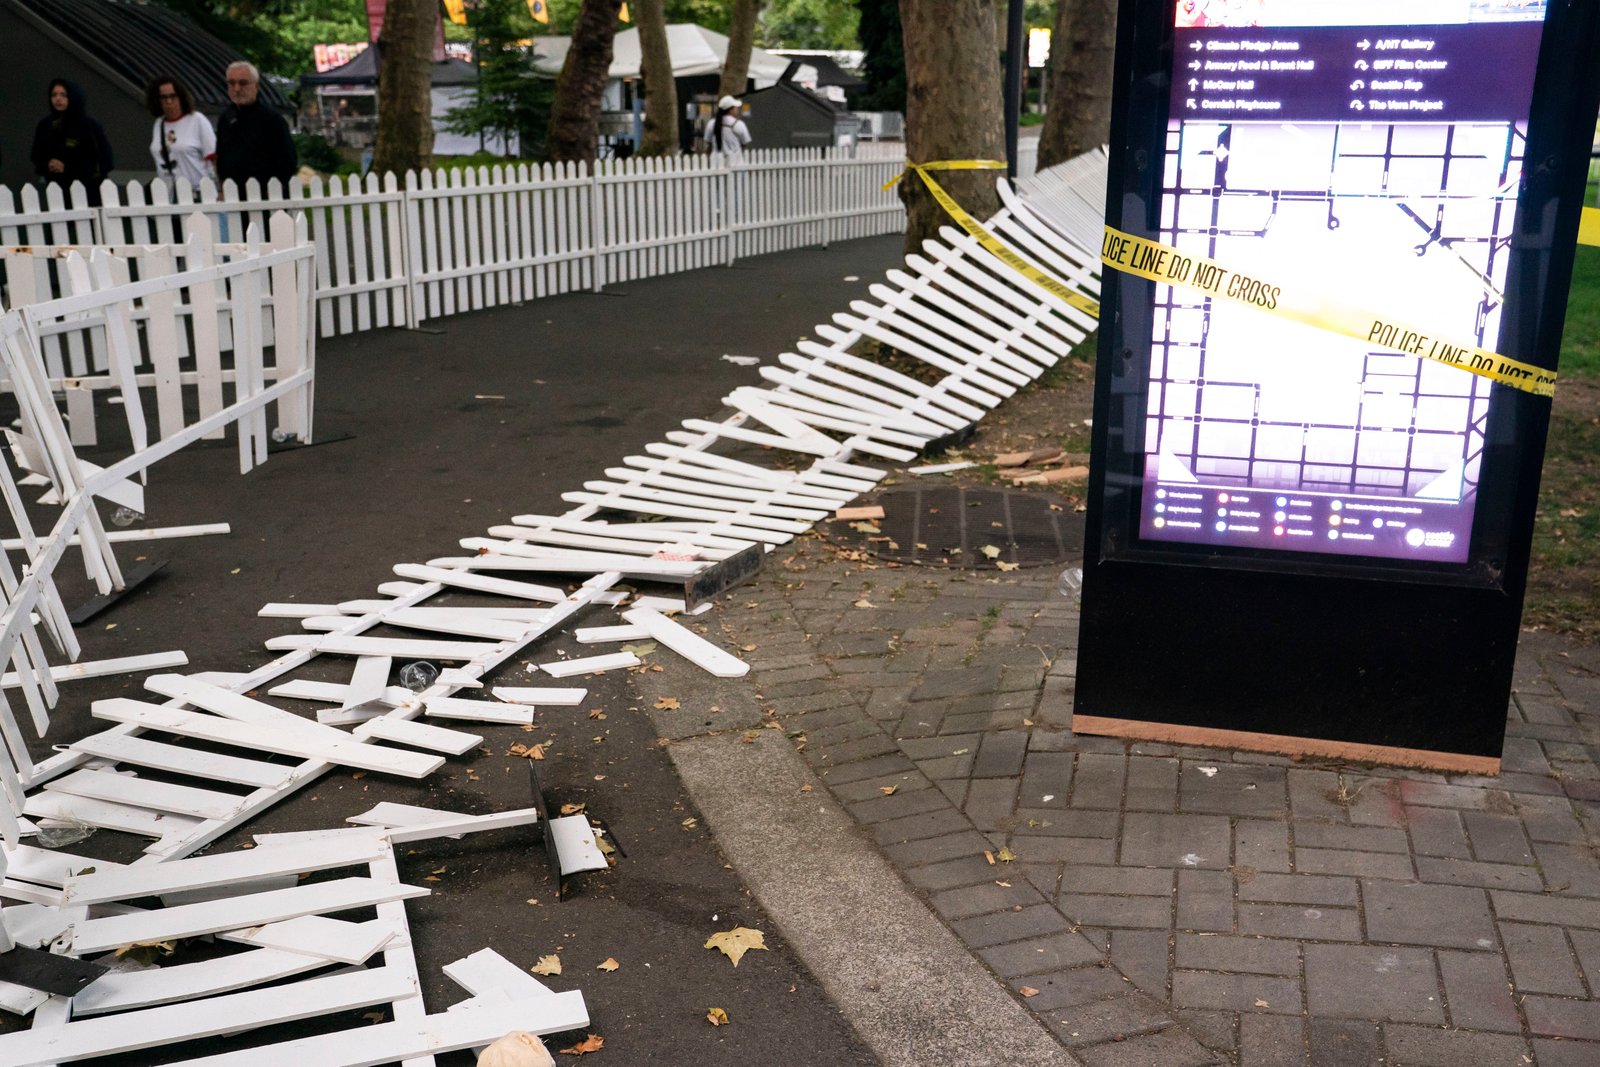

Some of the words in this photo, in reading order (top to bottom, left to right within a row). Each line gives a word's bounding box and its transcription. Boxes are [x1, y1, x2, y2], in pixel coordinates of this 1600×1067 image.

[1401, 39, 1435, 51] Gallery
[1415, 60, 1447, 69] Center
[1130, 243, 1169, 275] LINE
[1166, 254, 1192, 282] DO
[1191, 262, 1228, 293] NOT
[1227, 273, 1281, 310] CROSS
[1368, 320, 1428, 355] POLICE
